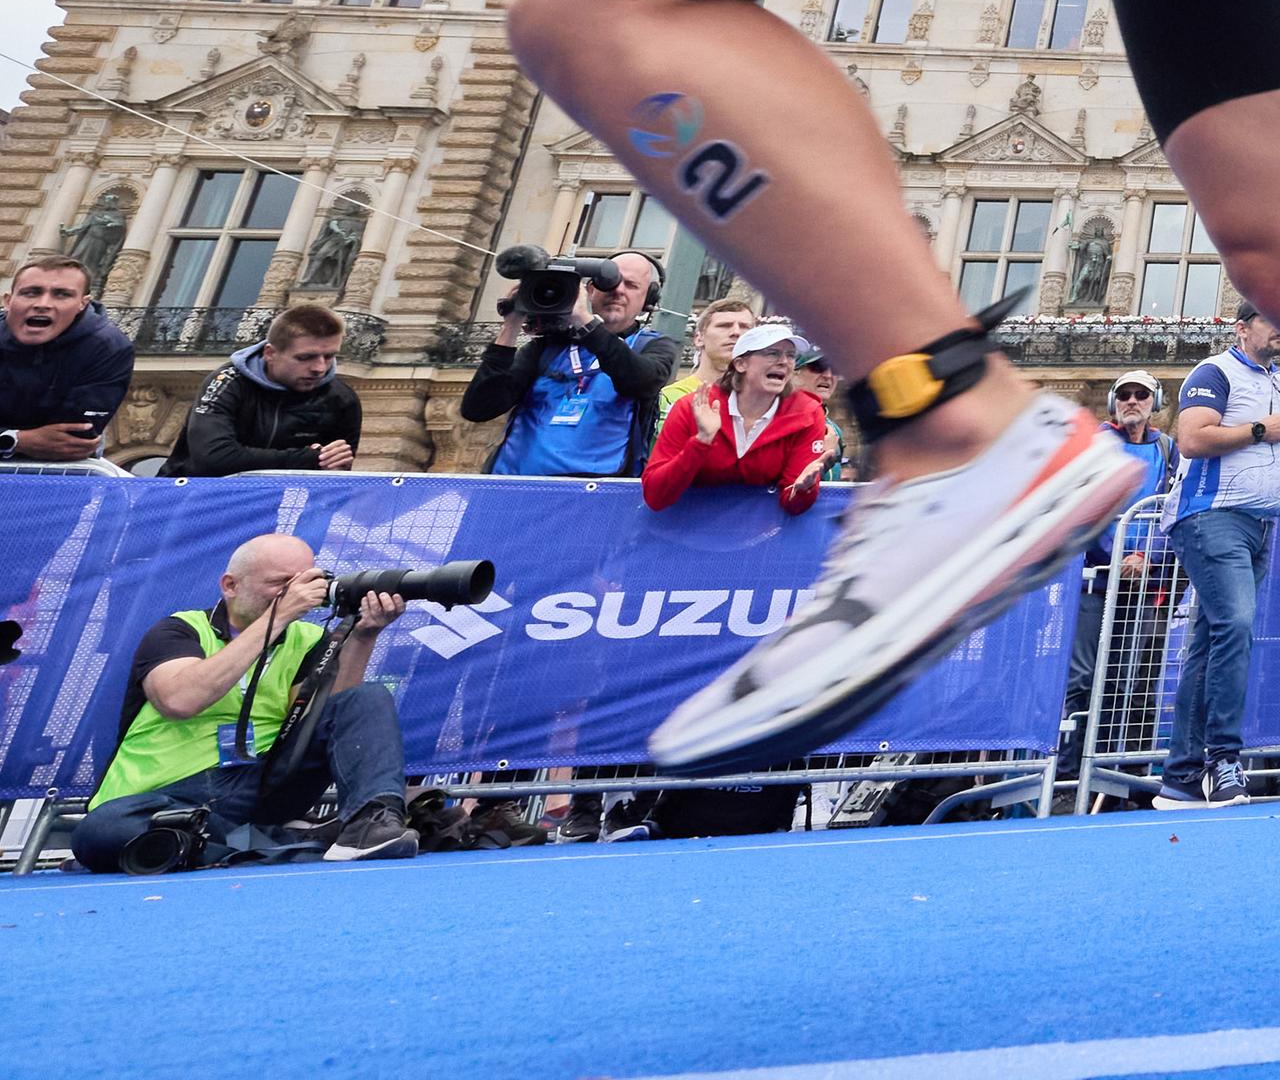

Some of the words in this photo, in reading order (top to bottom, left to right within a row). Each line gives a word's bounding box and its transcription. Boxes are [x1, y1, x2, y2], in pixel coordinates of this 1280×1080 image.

[683, 141, 768, 218] 2
[525, 589, 817, 640] SUZU
[315, 640, 339, 674] SONY
